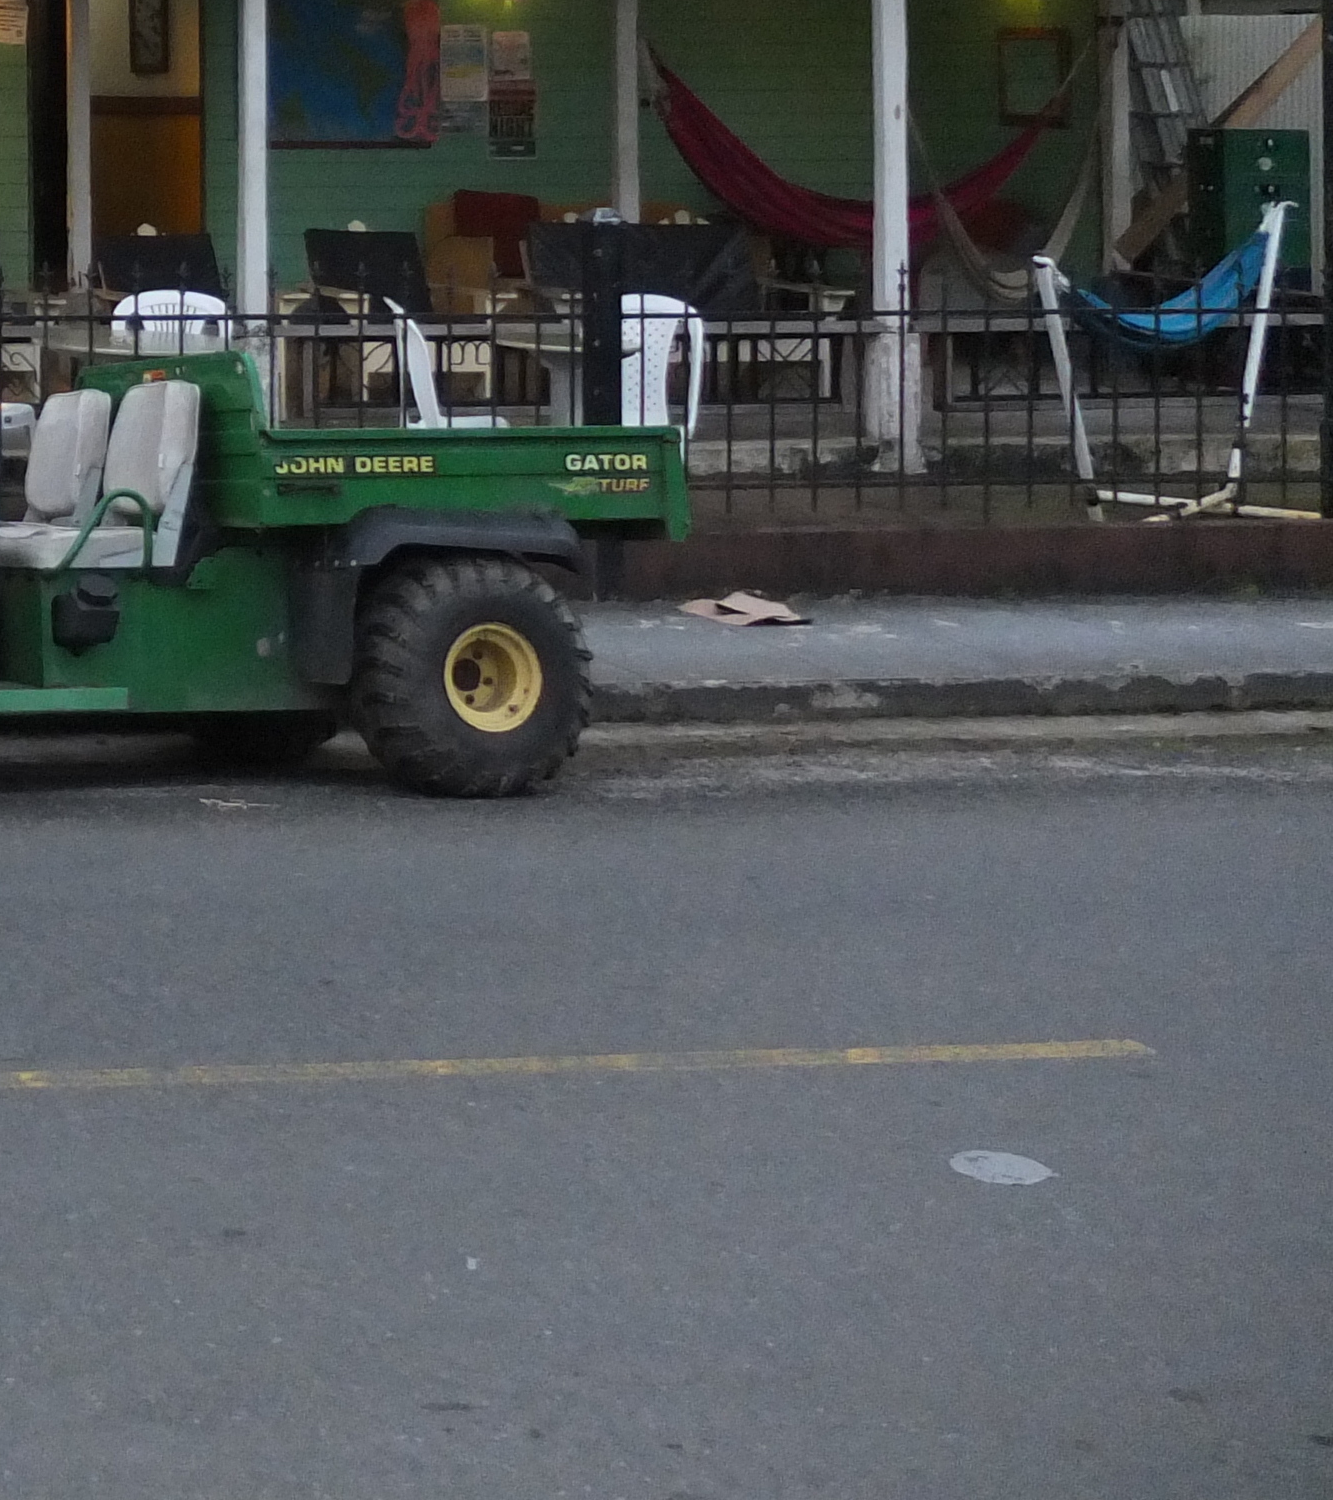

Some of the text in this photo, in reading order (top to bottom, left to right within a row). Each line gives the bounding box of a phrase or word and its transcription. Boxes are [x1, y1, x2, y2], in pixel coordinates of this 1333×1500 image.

[275, 456, 434, 474] JOHN DEERE
[564, 453, 648, 471] GATOR
[598, 477, 650, 492] TURF
